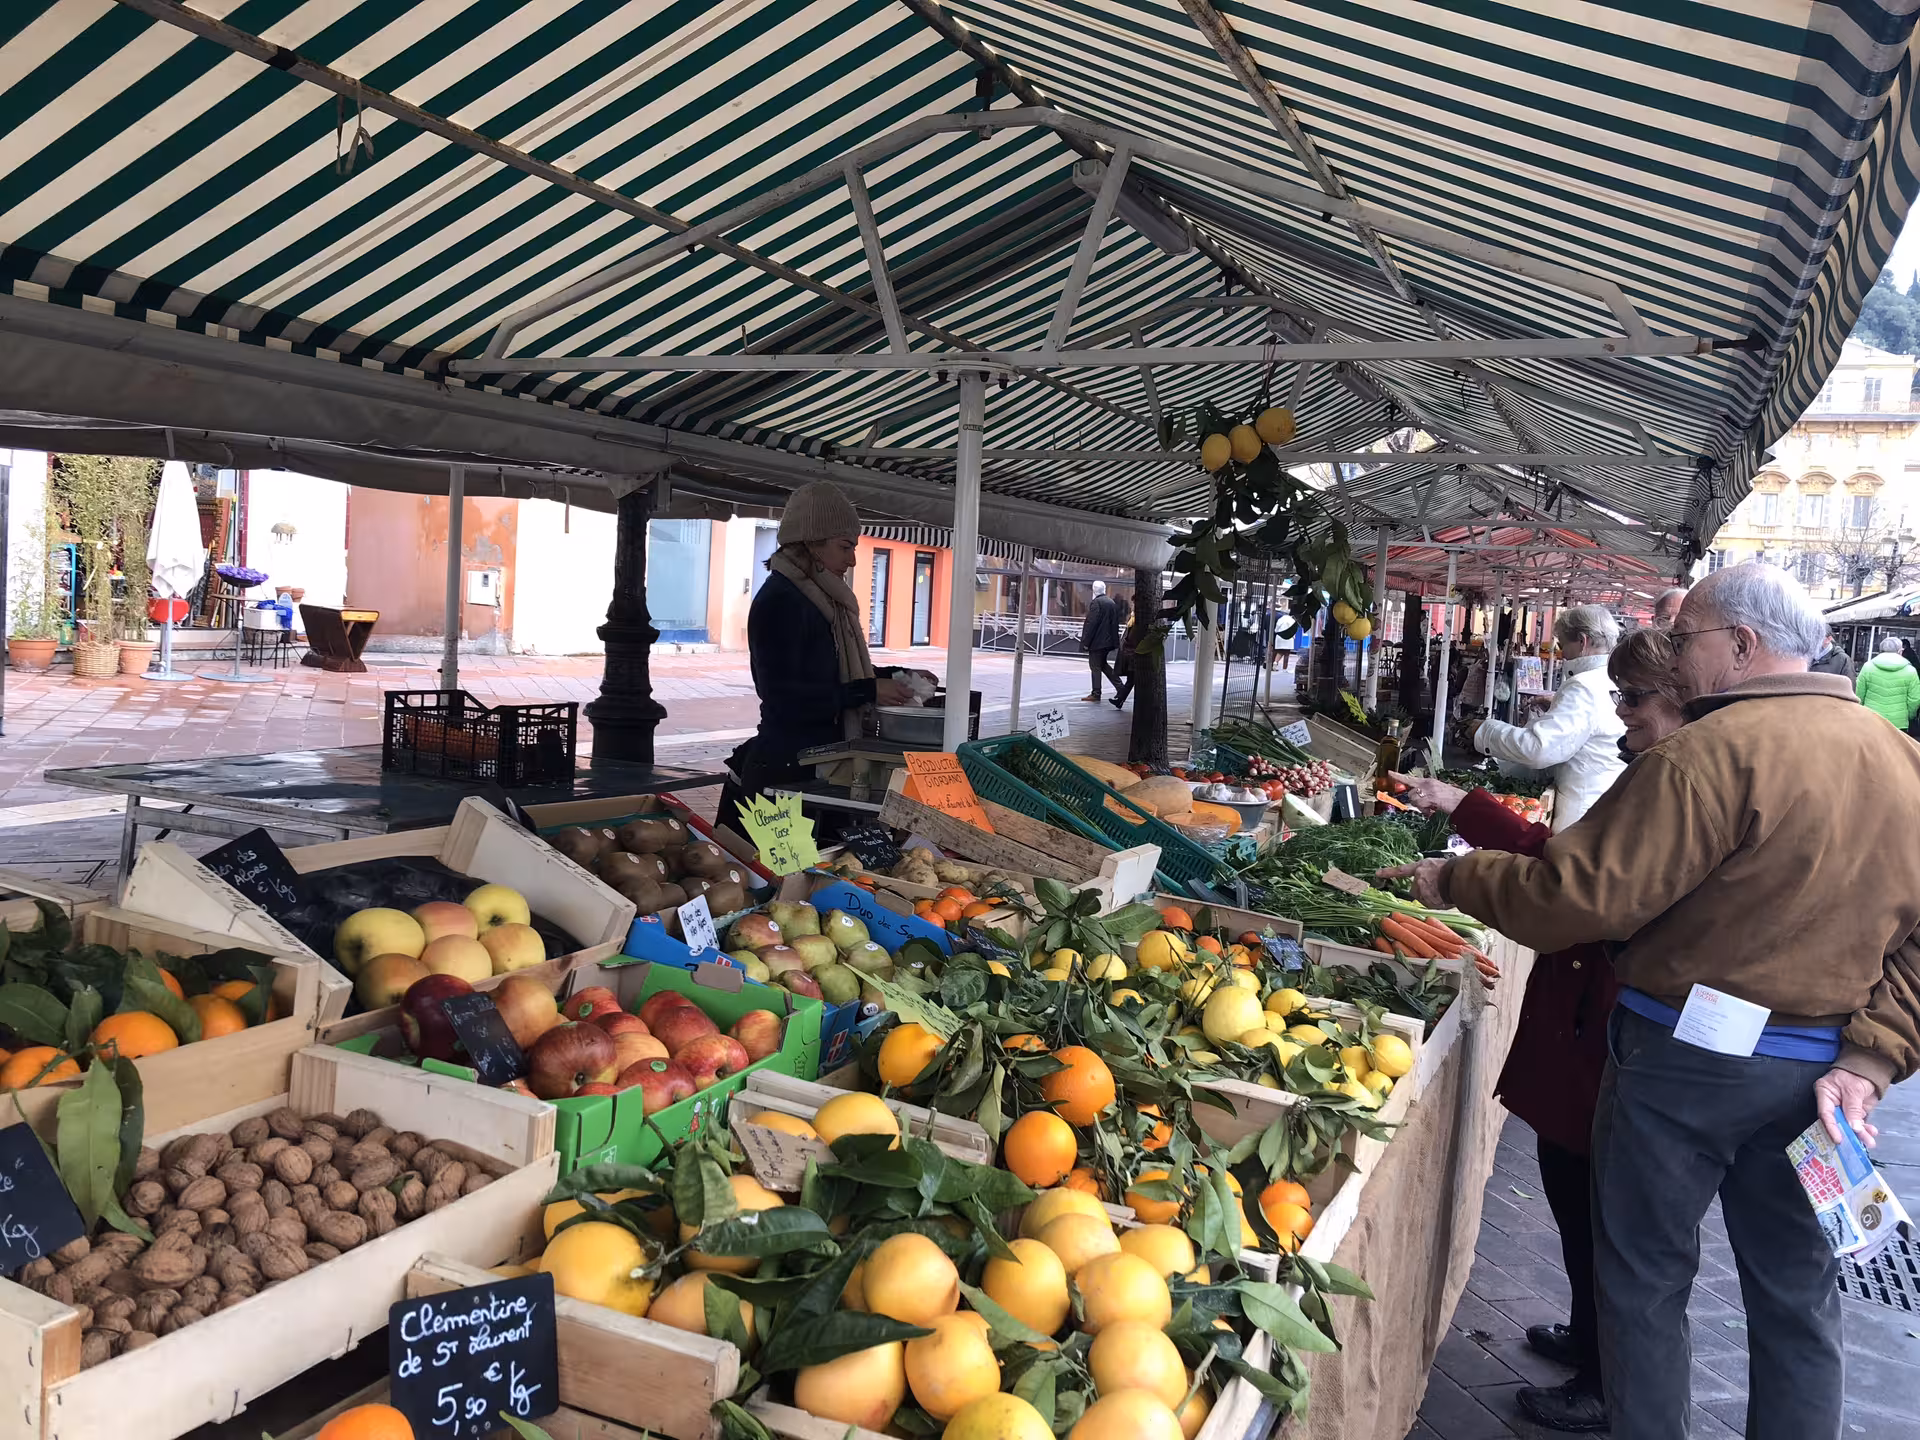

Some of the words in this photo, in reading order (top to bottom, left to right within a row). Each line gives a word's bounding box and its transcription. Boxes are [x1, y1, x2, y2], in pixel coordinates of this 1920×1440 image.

[924, 773, 963, 788] GIORDANO
[237, 849, 258, 865] des
[233, 862, 269, 886] Alpes
[844, 891, 874, 921] Duo
[401, 1292, 528, 1342] Clémentine
[398, 1348, 423, 1378] de
[469, 1302, 537, 1355] Laurent
[432, 1382, 488, 1437] 5,90
[483, 1361, 503, 1382] €
